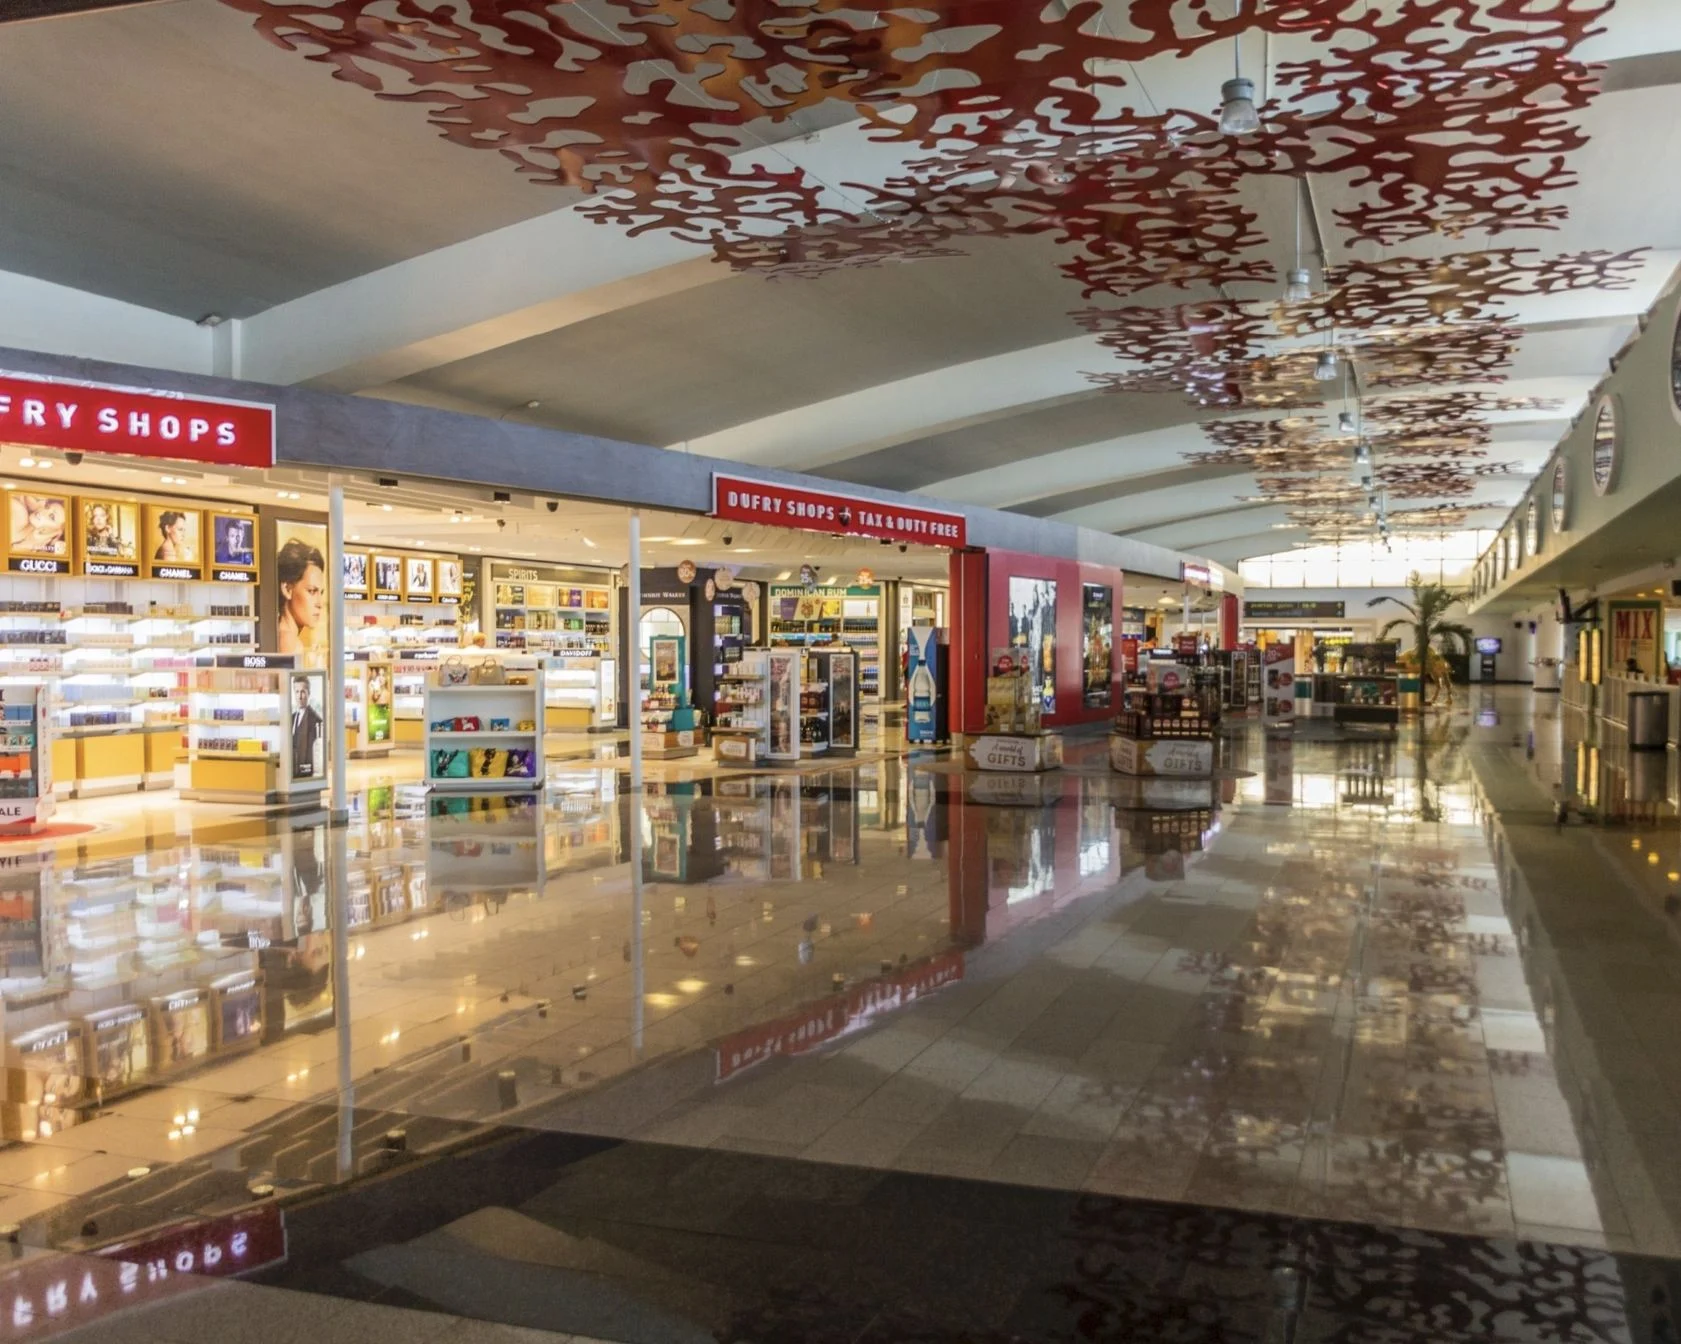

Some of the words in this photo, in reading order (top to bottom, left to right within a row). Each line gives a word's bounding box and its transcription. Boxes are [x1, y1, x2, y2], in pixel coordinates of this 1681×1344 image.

[97, 407, 236, 445] SHOPS
[727, 490, 782, 513] DUFRY
[786, 500, 835, 520] SHOPS
[858, 511, 882, 528] TAX
[885, 516, 894, 529] &
[896, 517, 927, 534] DUTY
[930, 522, 958, 538] FREE
[20, 560, 57, 572] GUCCI
[160, 568, 192, 579] CHANEL
[219, 571, 249, 581] CHANEL
[508, 568, 538, 581] SPIRITS
[827, 588, 848, 598] RUM
[1615, 610, 1654, 639] MIX
[560, 650, 593, 658] DAVIDOFF
[244, 656, 266, 665] BOSS
[986, 752, 1027, 767] GIFTS
[1163, 757, 1203, 772] GIFTS
